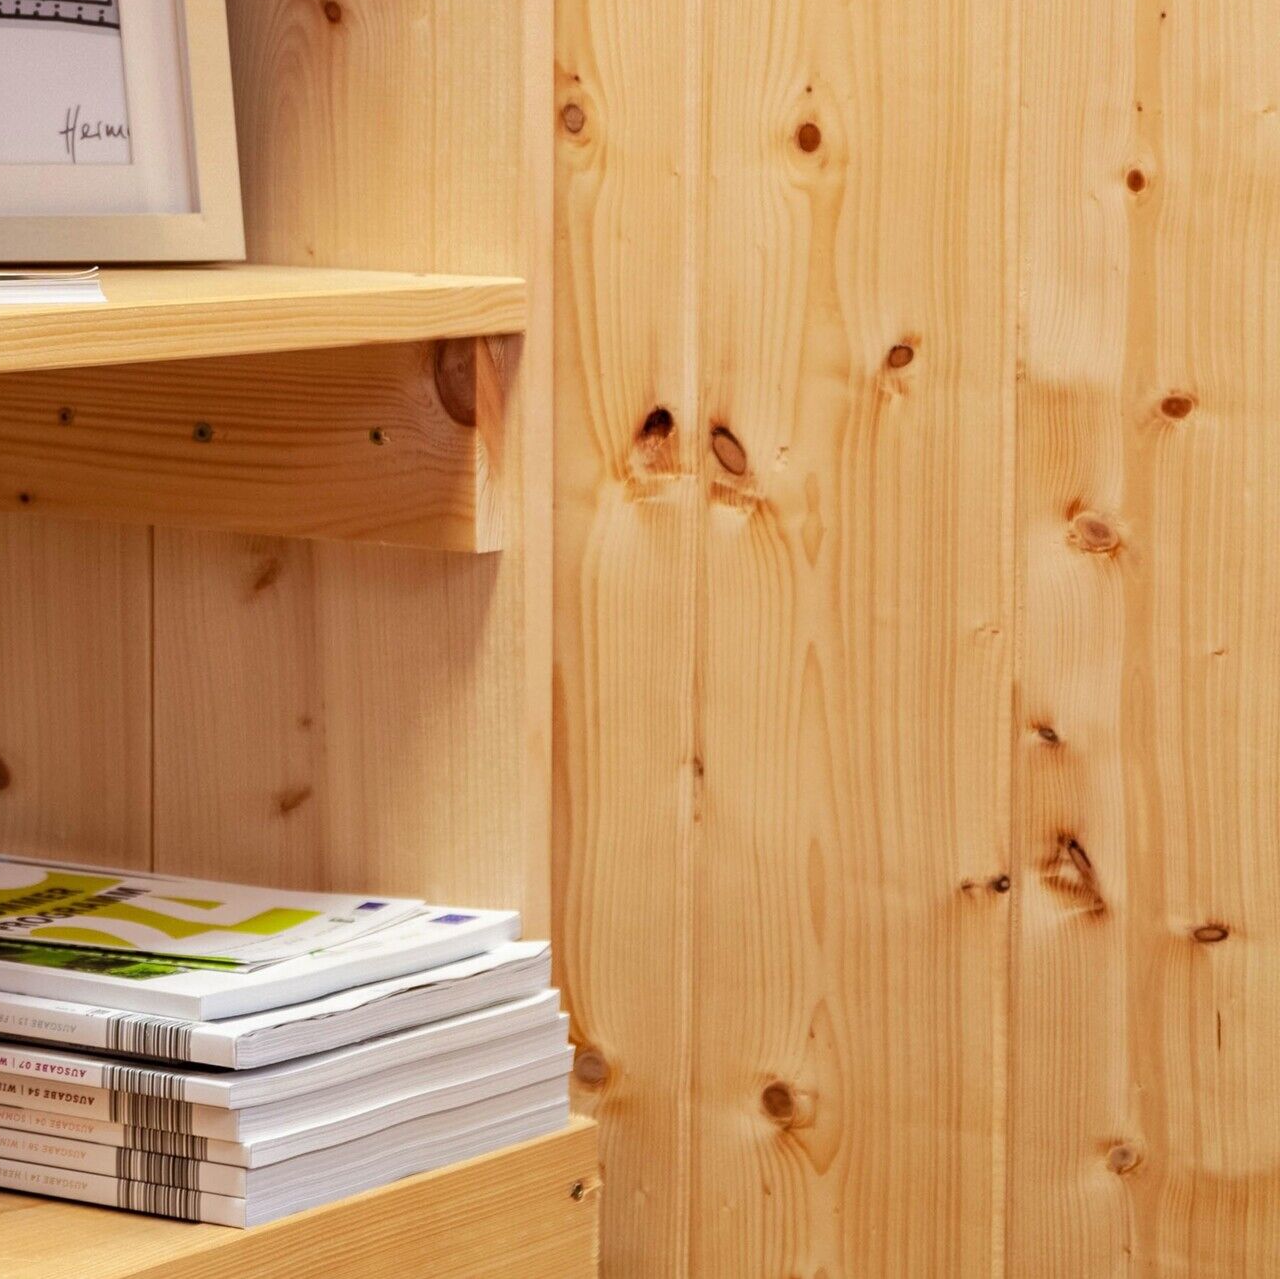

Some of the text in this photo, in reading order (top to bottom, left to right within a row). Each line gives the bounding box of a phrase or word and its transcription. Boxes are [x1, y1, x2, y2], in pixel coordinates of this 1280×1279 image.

[32, 1018, 78, 1034] AUSGABE
[18, 1060, 32, 1070] 07
[34, 1062, 88, 1078] AUSGABE
[28, 1087, 40, 1098] 54
[43, 1090, 96, 1106] AUSGABE
[48, 1120, 95, 1134] AUSGABE
[41, 1146, 87, 1160] AUSGABE
[43, 1174, 88, 1190] AUSGABE
